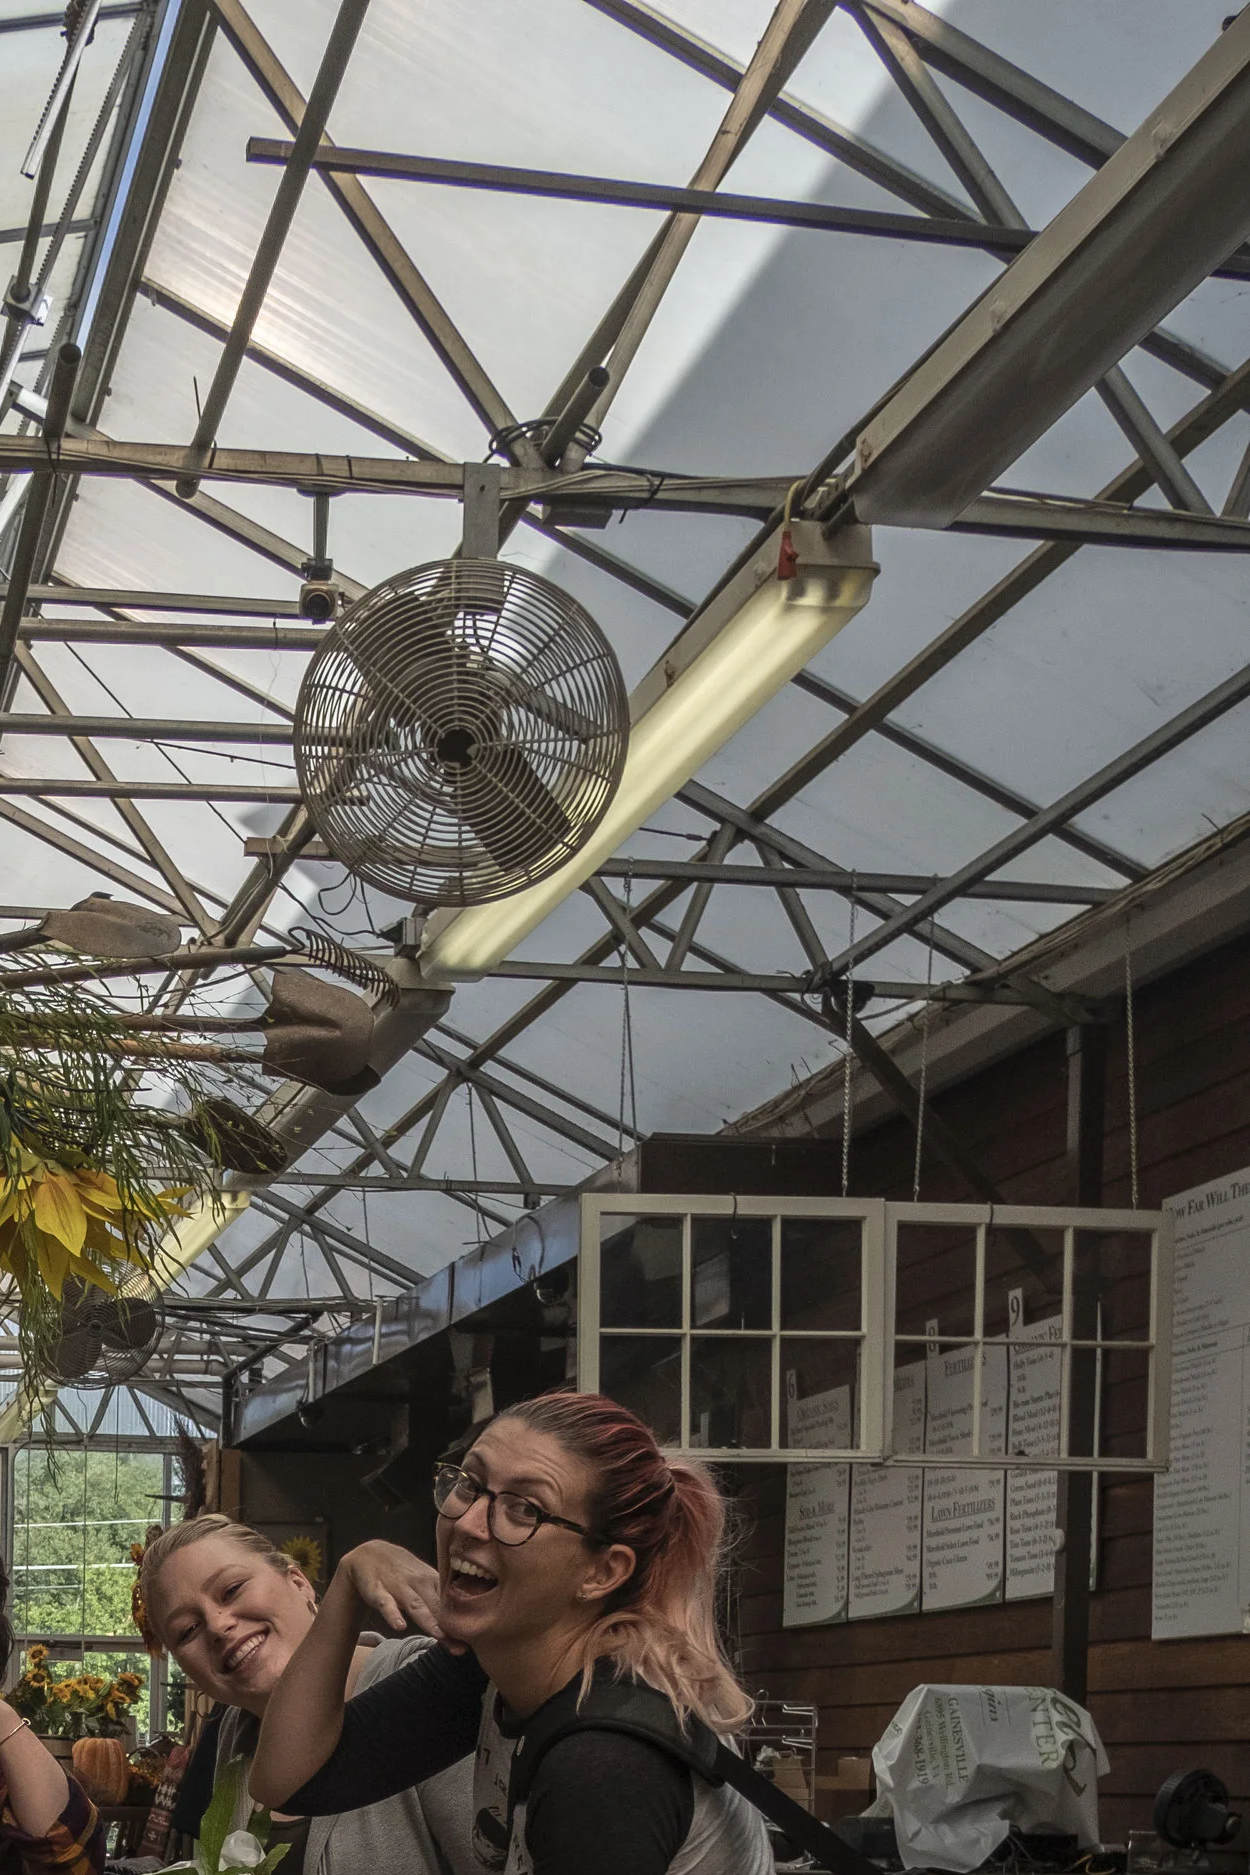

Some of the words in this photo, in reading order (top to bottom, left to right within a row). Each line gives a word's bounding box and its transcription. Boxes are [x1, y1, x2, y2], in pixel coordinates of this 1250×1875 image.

[1206, 1190, 1229, 1208] WILL
[1010, 1296, 1020, 1328] 9
[928, 1326, 937, 1353] 8
[788, 1371, 796, 1399] 6
[931, 1505, 951, 1521] LAWN
[953, 1497, 995, 1518] FERTILIZERS
[947, 1696, 969, 1784] GAINESVILLE
